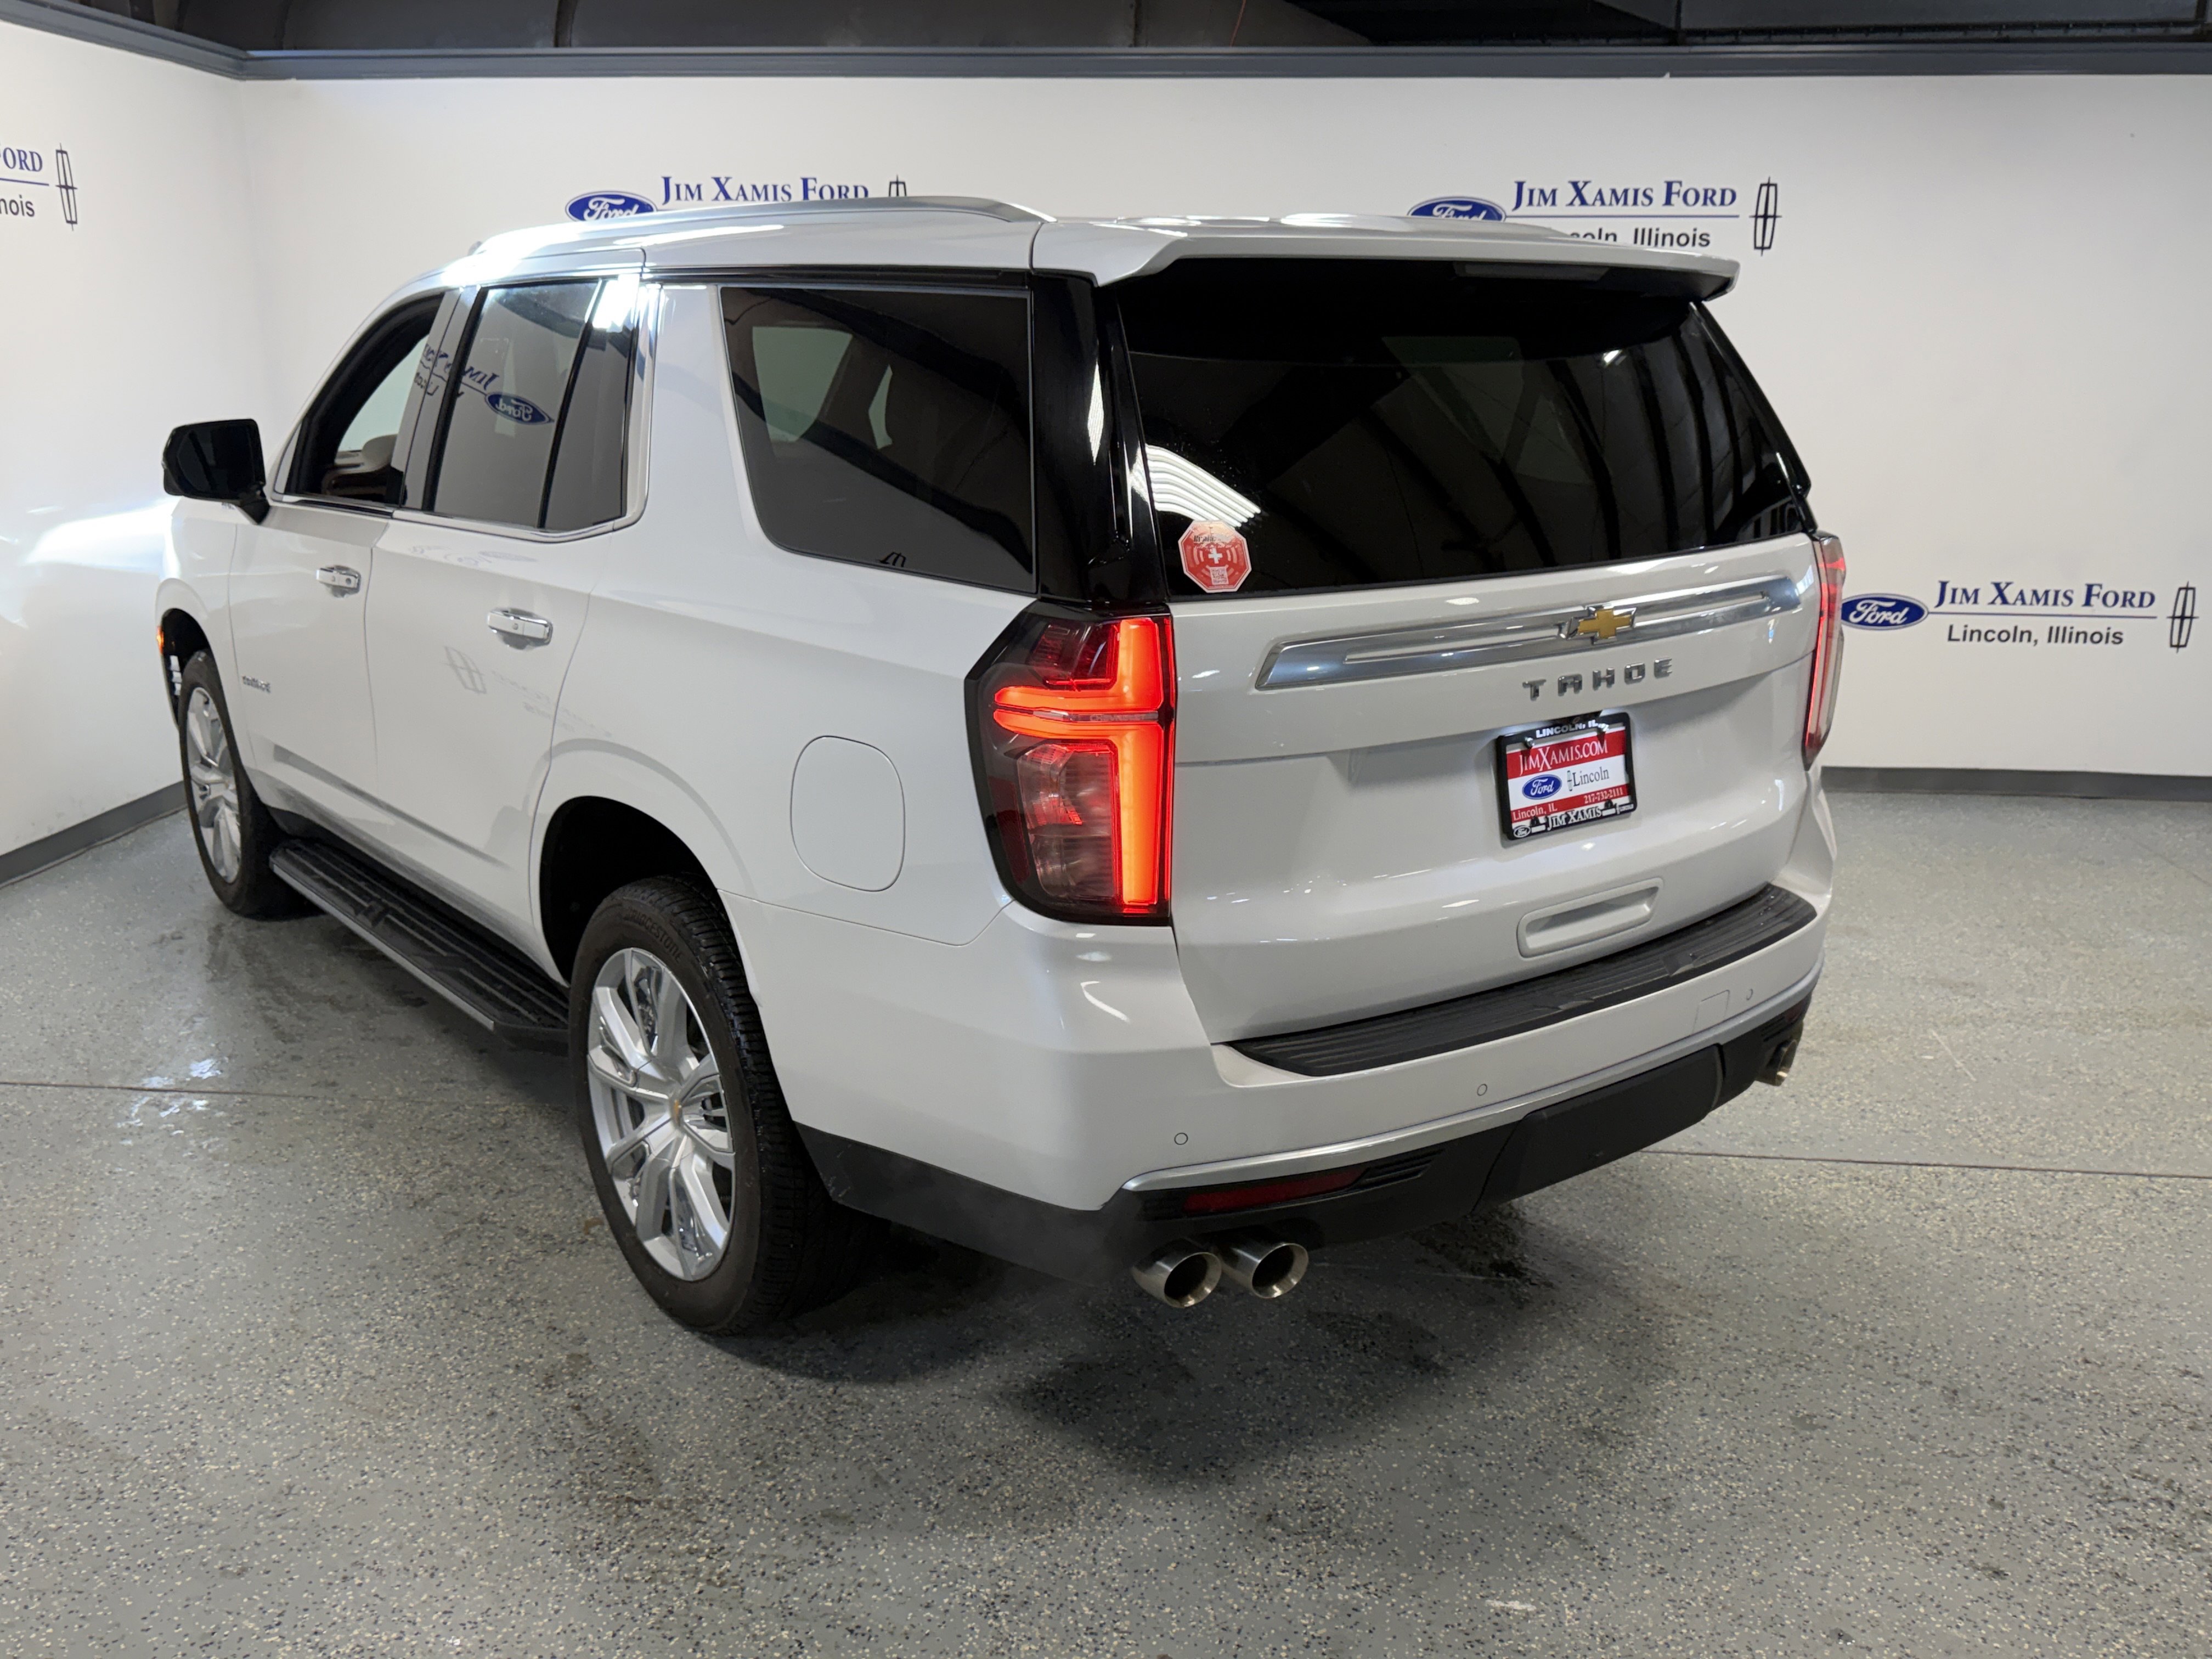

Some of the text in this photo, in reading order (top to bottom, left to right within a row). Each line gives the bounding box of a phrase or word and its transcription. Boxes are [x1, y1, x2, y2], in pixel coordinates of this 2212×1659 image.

[0, 147, 42, 172] ORD
[1633, 228, 1711, 247] Illinois
[1948, 624, 2124, 647] Lincoln, Illinois
[1522, 657, 1673, 701] TAHOE
[1536, 724, 1585, 738] LINCOLN,
[1572, 766, 1610, 787] Lincoln
[1549, 803, 1558, 812] IL
